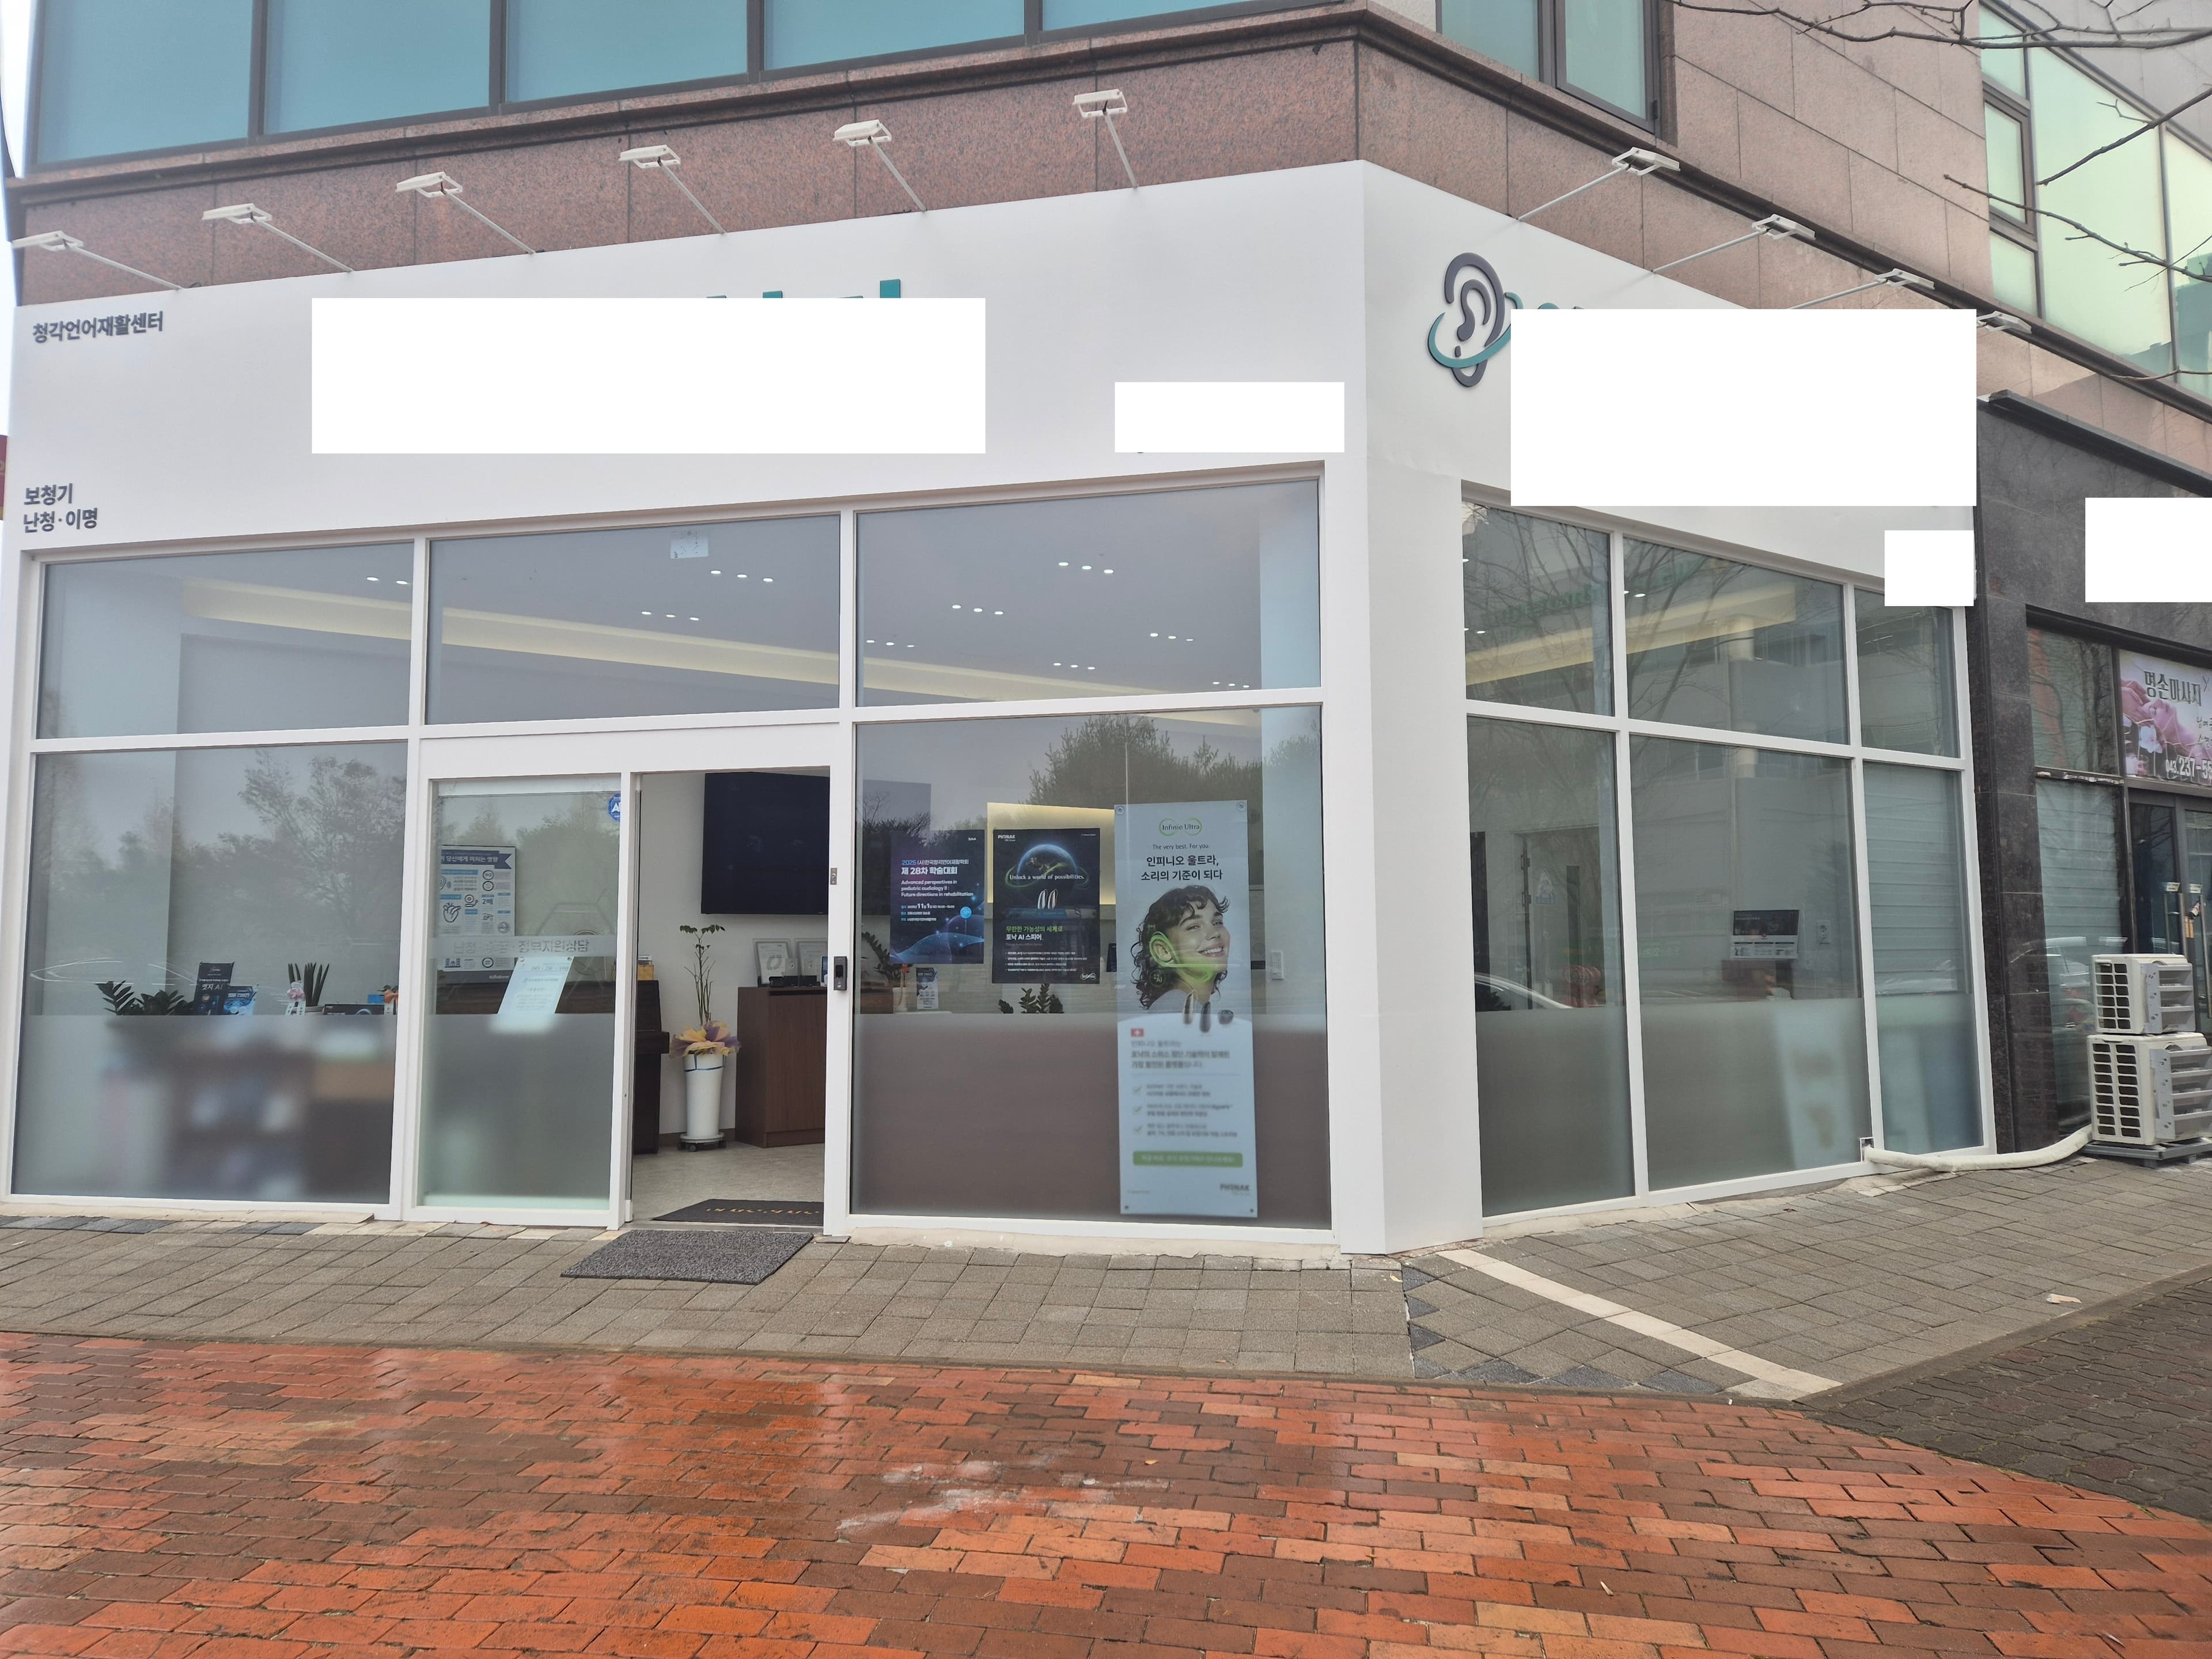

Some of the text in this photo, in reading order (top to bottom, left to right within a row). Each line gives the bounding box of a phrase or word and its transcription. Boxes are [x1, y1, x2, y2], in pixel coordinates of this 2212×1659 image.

[32, 311, 163, 343] 청각언어재활센터
[24, 483, 73, 506] 보청기
[2144, 671, 2202, 706] 명손마사지
[1146, 854, 1219, 867] 인피니오 울트라,
[902, 866, 957, 875] 제 28차 학술대회
[1141, 869, 1223, 881] 소리의 기준이 되다
[518, 940, 589, 953] 정부지원상담
